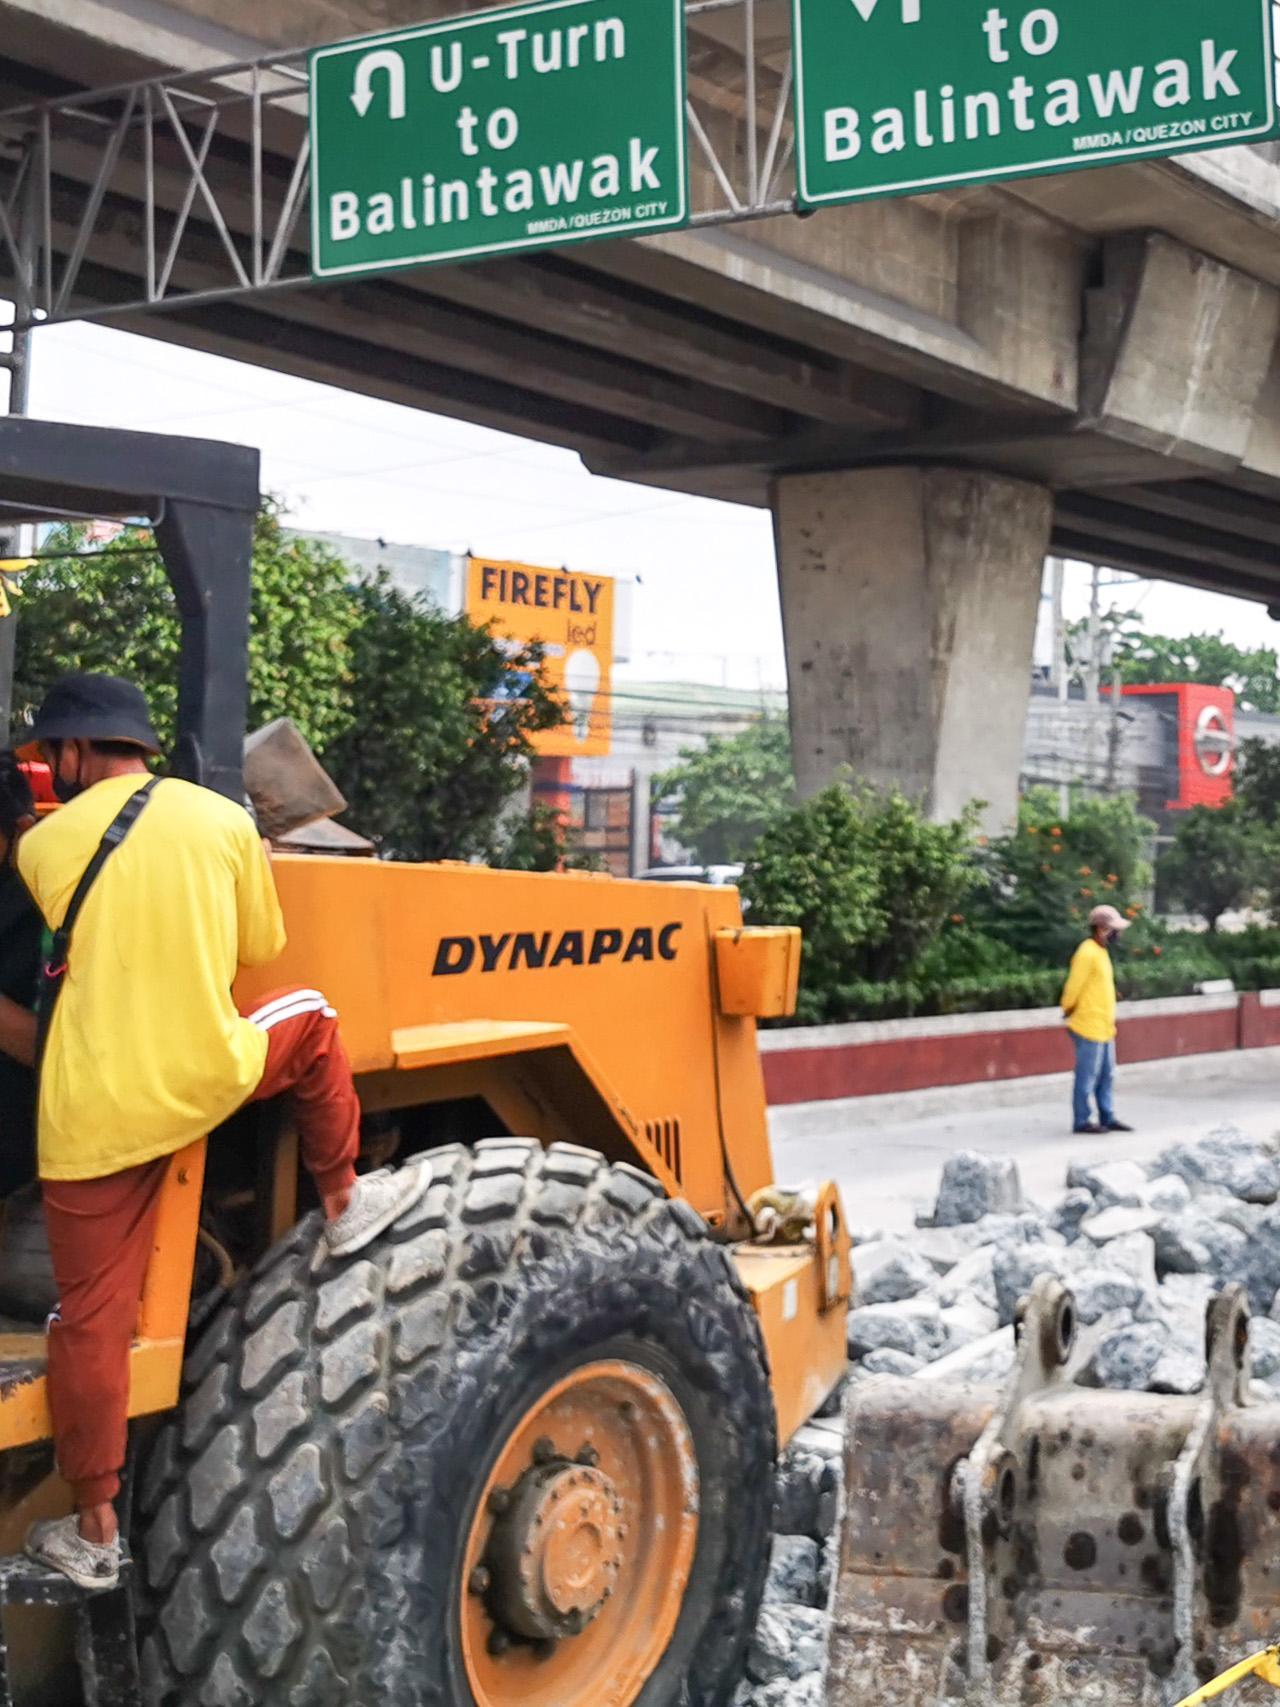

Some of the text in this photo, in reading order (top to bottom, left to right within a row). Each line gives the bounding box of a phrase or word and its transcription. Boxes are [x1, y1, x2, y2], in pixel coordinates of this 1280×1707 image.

[431, 17, 625, 93] U-Turn
[982, 8, 1060, 63] to
[824, 38, 1240, 162] Balintawak
[1210, 112, 1253, 131] CITY
[457, 106, 519, 156] to
[330, 137, 661, 241] Balintawak
[635, 202, 668, 219] CITY
[481, 566, 602, 614] FIREFLY
[566, 619, 597, 646] led
[432, 922, 683, 977] DYNAPAC
